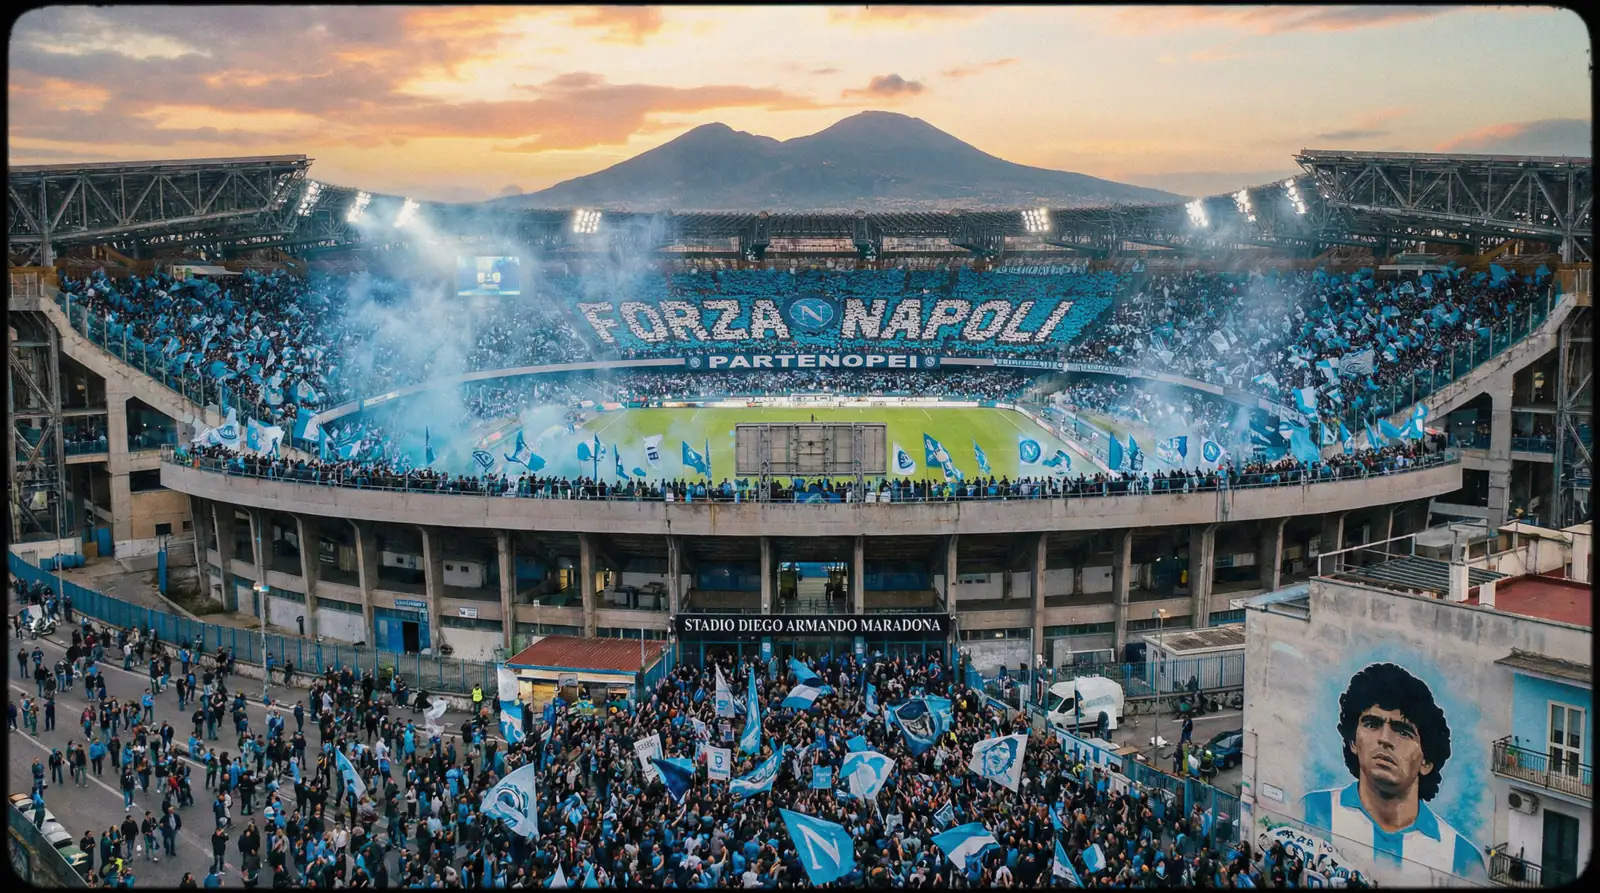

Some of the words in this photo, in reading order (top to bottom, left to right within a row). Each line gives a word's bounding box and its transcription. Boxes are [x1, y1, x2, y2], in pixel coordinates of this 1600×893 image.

[576, 299, 791, 343] FORZA
[841, 299, 1074, 343] NAPOLI
[709, 355, 917, 369] PARTENOPEI
[684, 619, 735, 632] STADIO
[738, 619, 783, 632] DIEGO
[786, 619, 857, 632] ARMANDO
[861, 619, 941, 632] MARADONA
[796, 823, 841, 870] N
